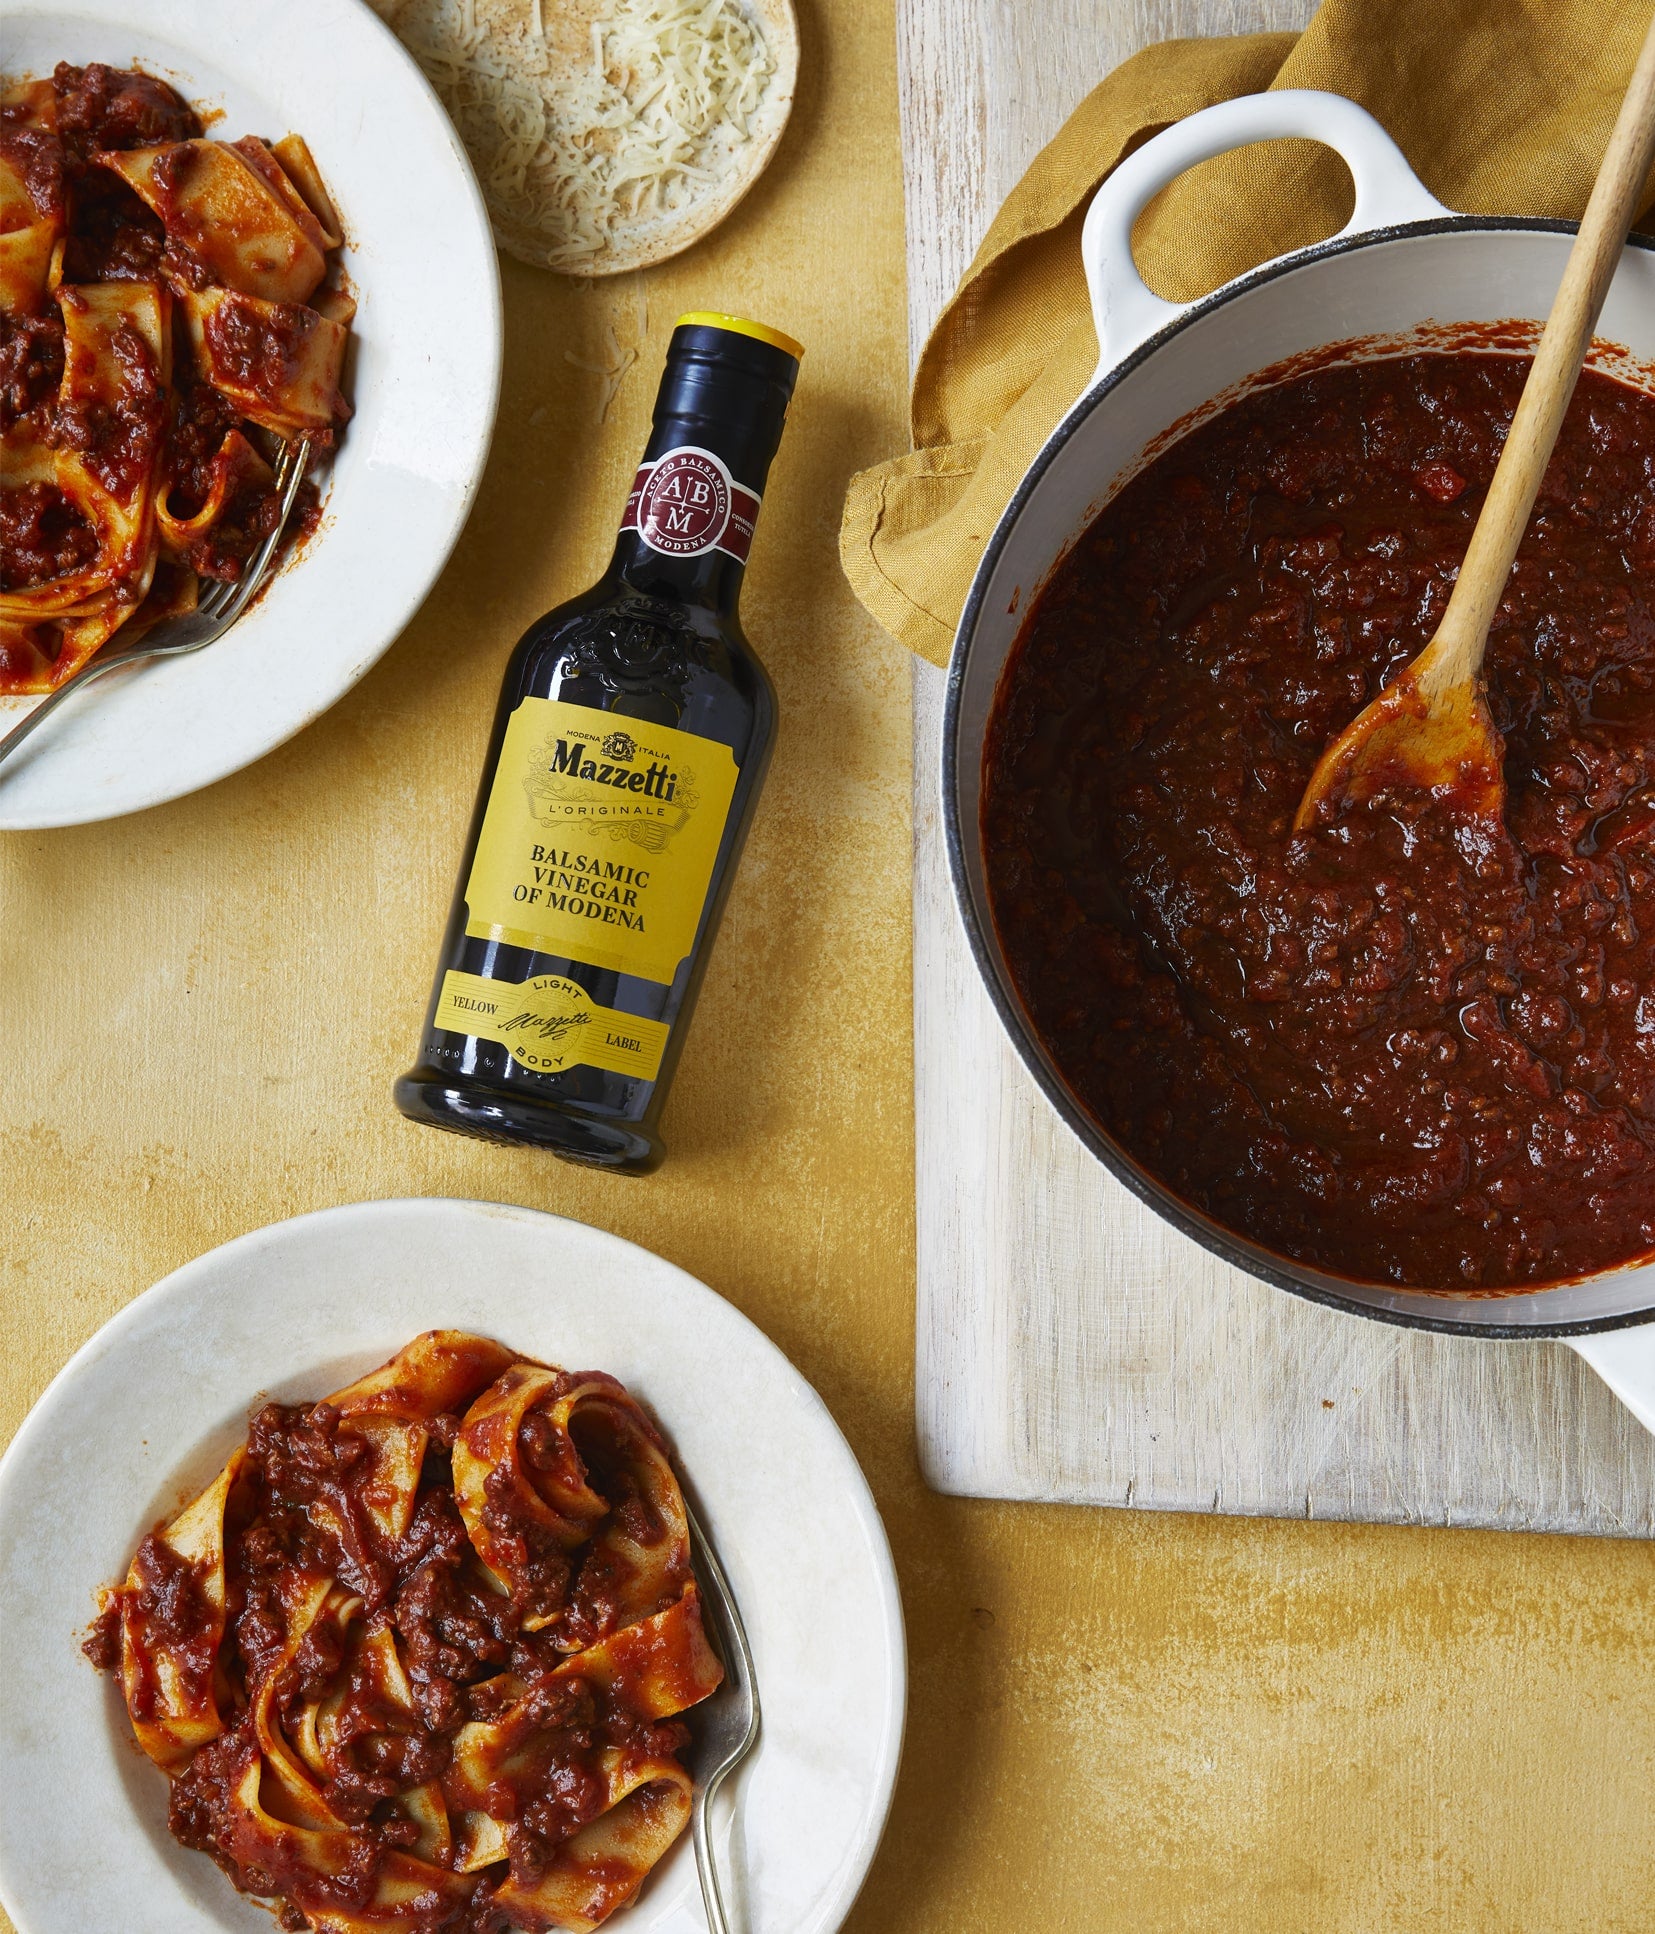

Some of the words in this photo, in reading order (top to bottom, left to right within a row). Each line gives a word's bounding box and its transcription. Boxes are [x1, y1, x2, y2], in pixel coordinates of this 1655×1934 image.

[646, 462, 675, 498] ACETO
[680, 457, 725, 513] BALSAMICO
[665, 507, 694, 534] M
[654, 534, 707, 550] MODENA
[566, 729, 601, 743] MODENA
[638, 746, 671, 761] ITALIA
[548, 738, 678, 802] Mazzetti
[549, 804, 666, 816] L'ORIGINALE
[530, 844, 650, 889] BALSAMIC
[533, 866, 638, 907] VINEGAR
[513, 884, 543, 904] OF
[545, 891, 646, 933] MODENA
[533, 979, 583, 1000] LIGHT
[453, 995, 499, 1016] YELLOW
[497, 1011, 593, 1041] Mazzetti
[515, 1046, 565, 1068] BODY
[605, 1033, 643, 1053] LABEL
